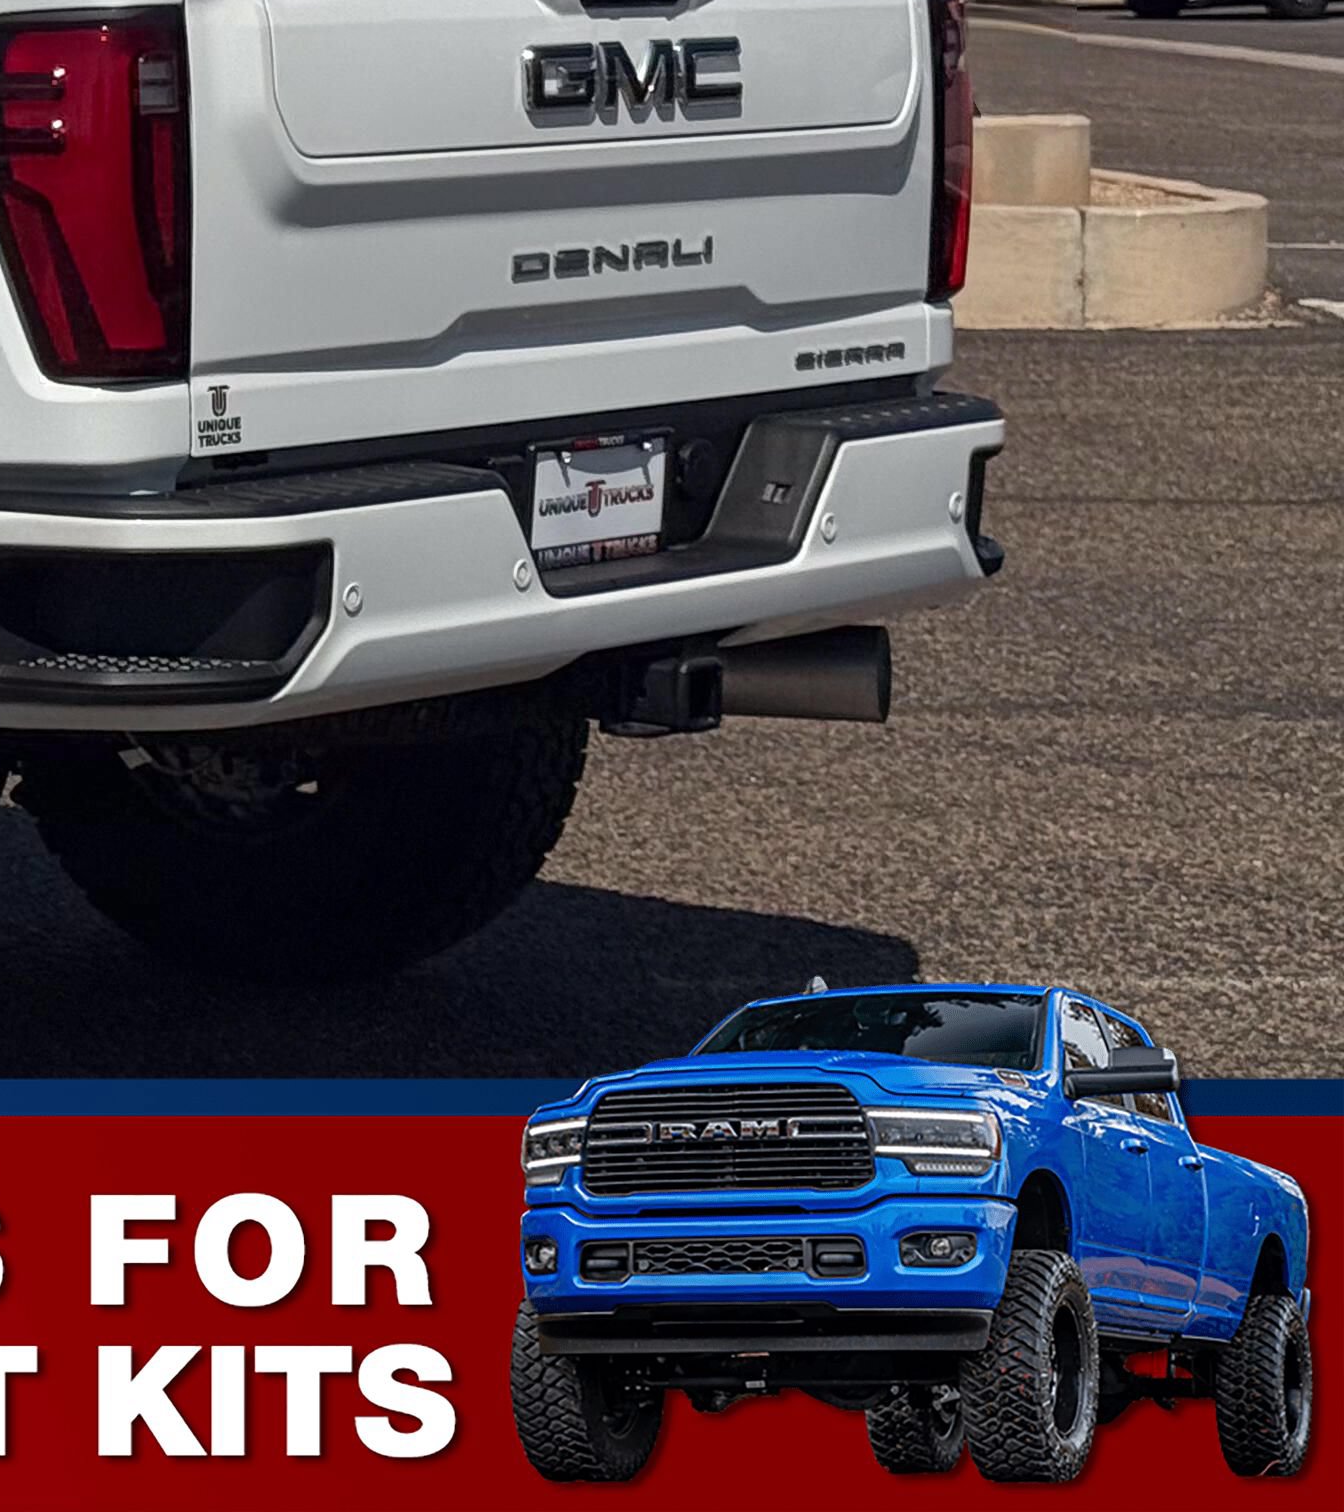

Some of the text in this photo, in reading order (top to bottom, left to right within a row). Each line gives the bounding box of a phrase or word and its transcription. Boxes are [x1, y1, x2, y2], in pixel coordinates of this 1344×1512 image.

[521, 36, 743, 112] GMC
[512, 235, 714, 283] DENALI
[795, 342, 906, 371] SIERRA
[197, 416, 242, 433] UNIQUE
[197, 431, 242, 448] TRUCKS
